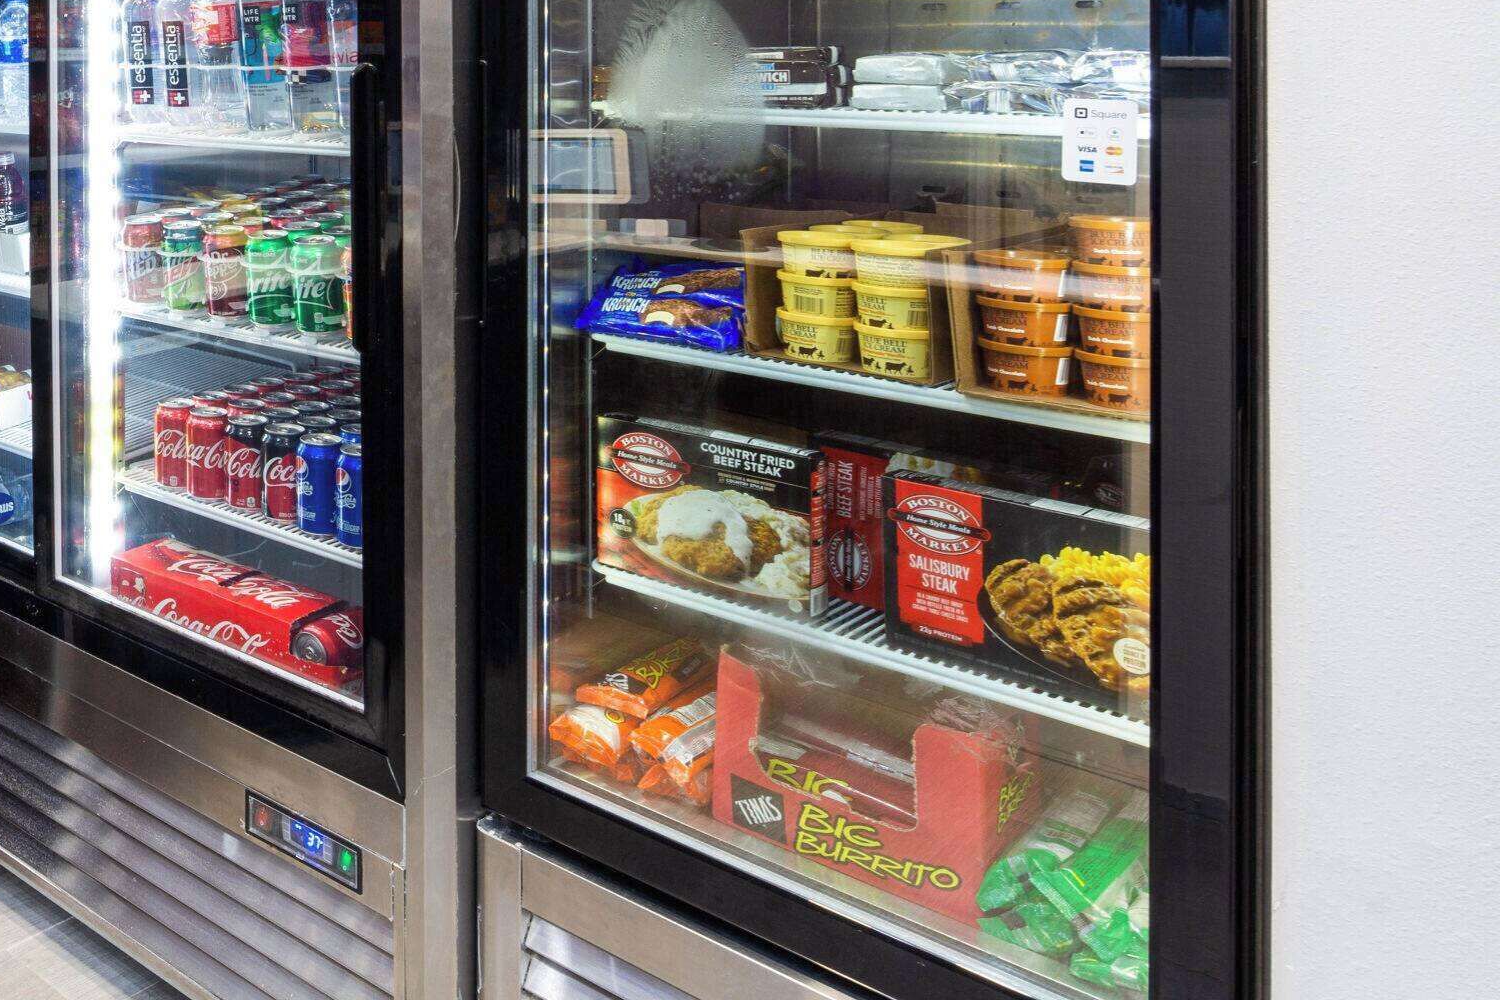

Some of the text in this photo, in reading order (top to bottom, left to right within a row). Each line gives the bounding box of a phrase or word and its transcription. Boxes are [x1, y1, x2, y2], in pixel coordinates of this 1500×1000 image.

[131, 25, 145, 83] essentia
[166, 25, 179, 85] essentia
[1090, 109, 1127, 120] Square
[1078, 145, 1098, 153] VISA
[601, 297, 651, 314] KRUNCH
[620, 434, 675, 458] BOSTON
[700, 442, 796, 470] COUNTRY FRIED
[619, 461, 675, 487] MARKET
[713, 454, 782, 478] BEEF STEAK
[906, 495, 970, 522] BOSTON
[907, 514, 971, 534] Home Style Meals
[906, 526, 970, 553] MARKET
[908, 553, 970, 581] SALISBURY
[921, 574, 958, 594] STEAK
[799, 803, 883, 848] BIG
[795, 831, 960, 889] BURRITO
